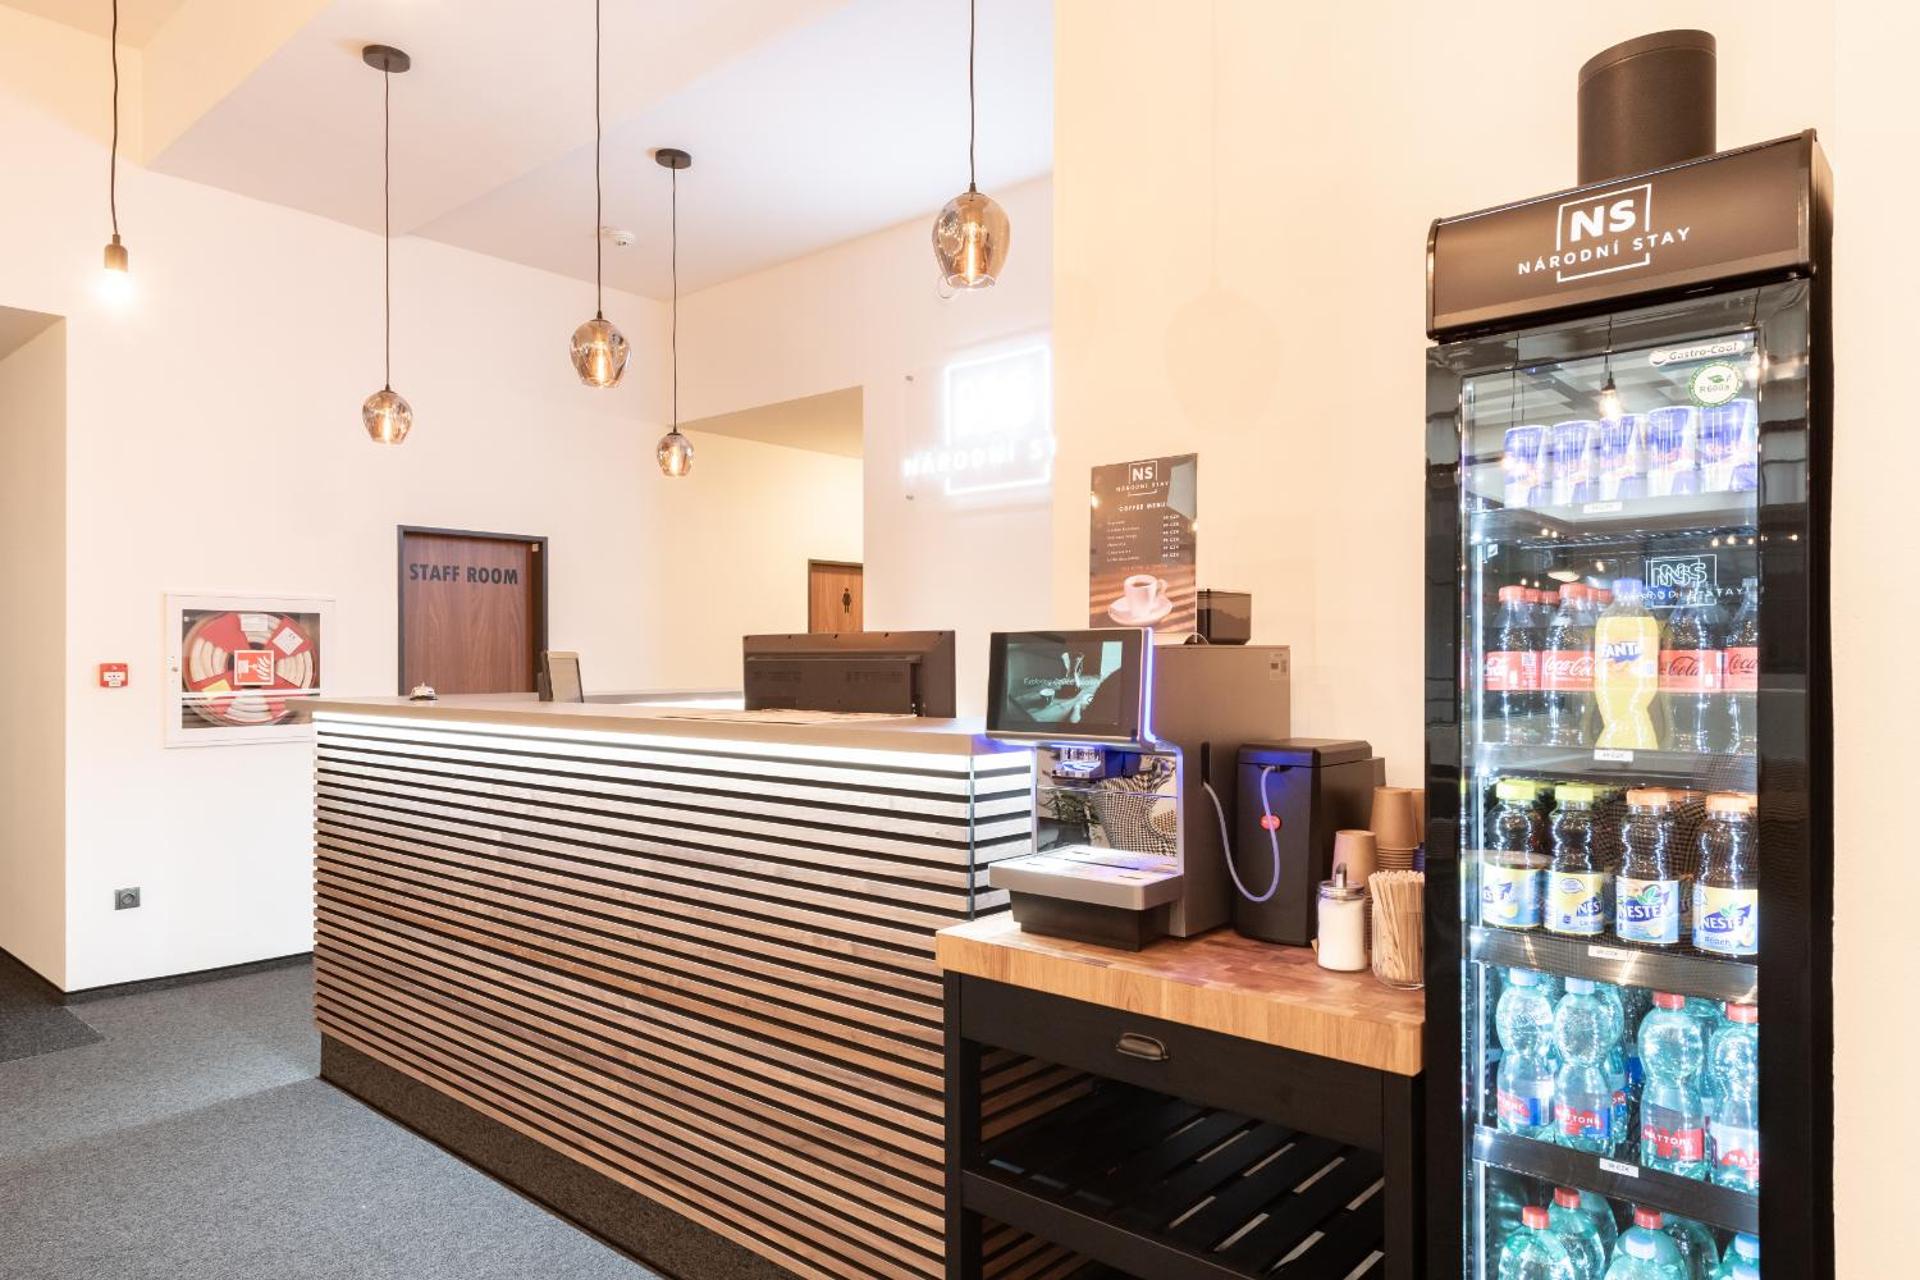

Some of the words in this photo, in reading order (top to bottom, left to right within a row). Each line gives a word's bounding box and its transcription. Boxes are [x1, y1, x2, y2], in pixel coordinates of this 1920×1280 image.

[1569, 199, 1637, 243] NS
[1518, 242, 1620, 276] NÁRODNÍ
[1632, 226, 1691, 252] STAY
[1668, 342, 1737, 361] Gastro-Cool
[1132, 467, 1154, 482] NS
[409, 563, 460, 582] STAFF
[467, 567, 518, 585] ROOM
